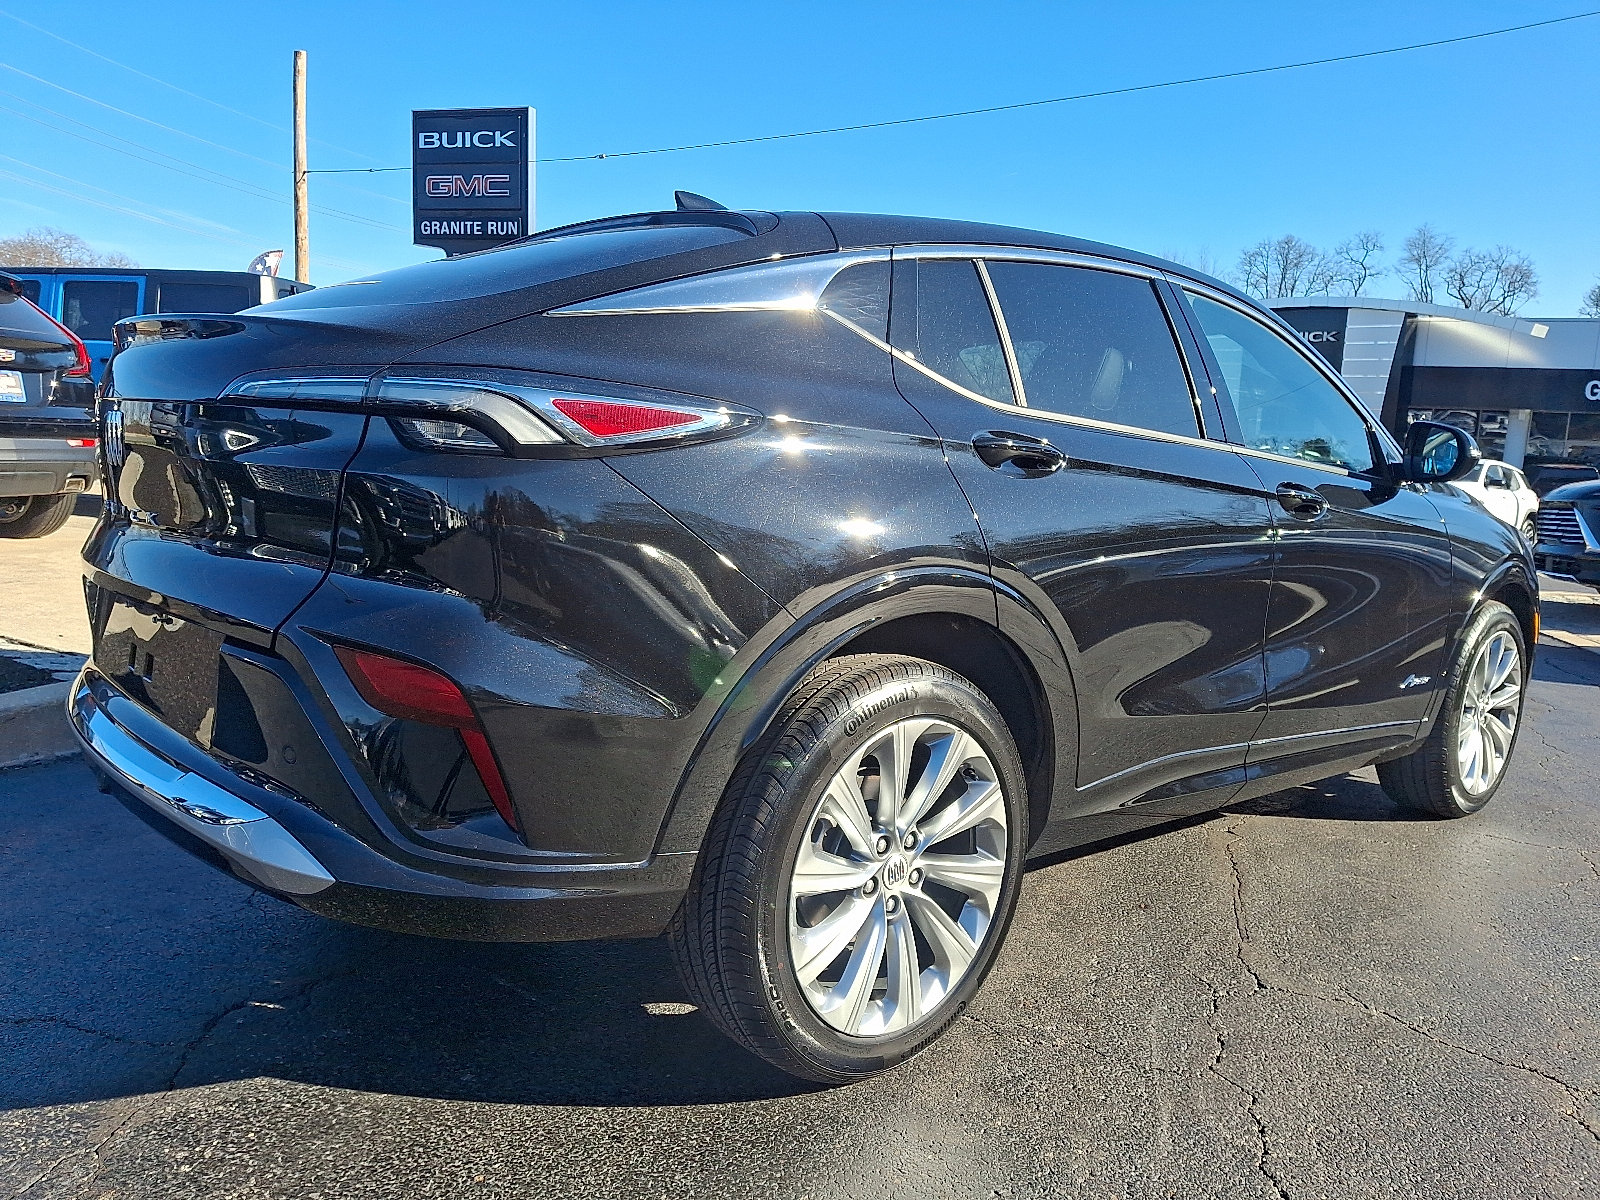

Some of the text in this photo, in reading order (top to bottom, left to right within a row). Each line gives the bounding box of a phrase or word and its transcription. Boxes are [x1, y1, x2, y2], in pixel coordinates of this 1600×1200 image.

[418, 130, 517, 149] BUICK
[425, 174, 510, 197] GMC
[420, 220, 518, 235] GRANITE RUN
[1585, 380, 1600, 401] G
[843, 686, 910, 738] Continental
